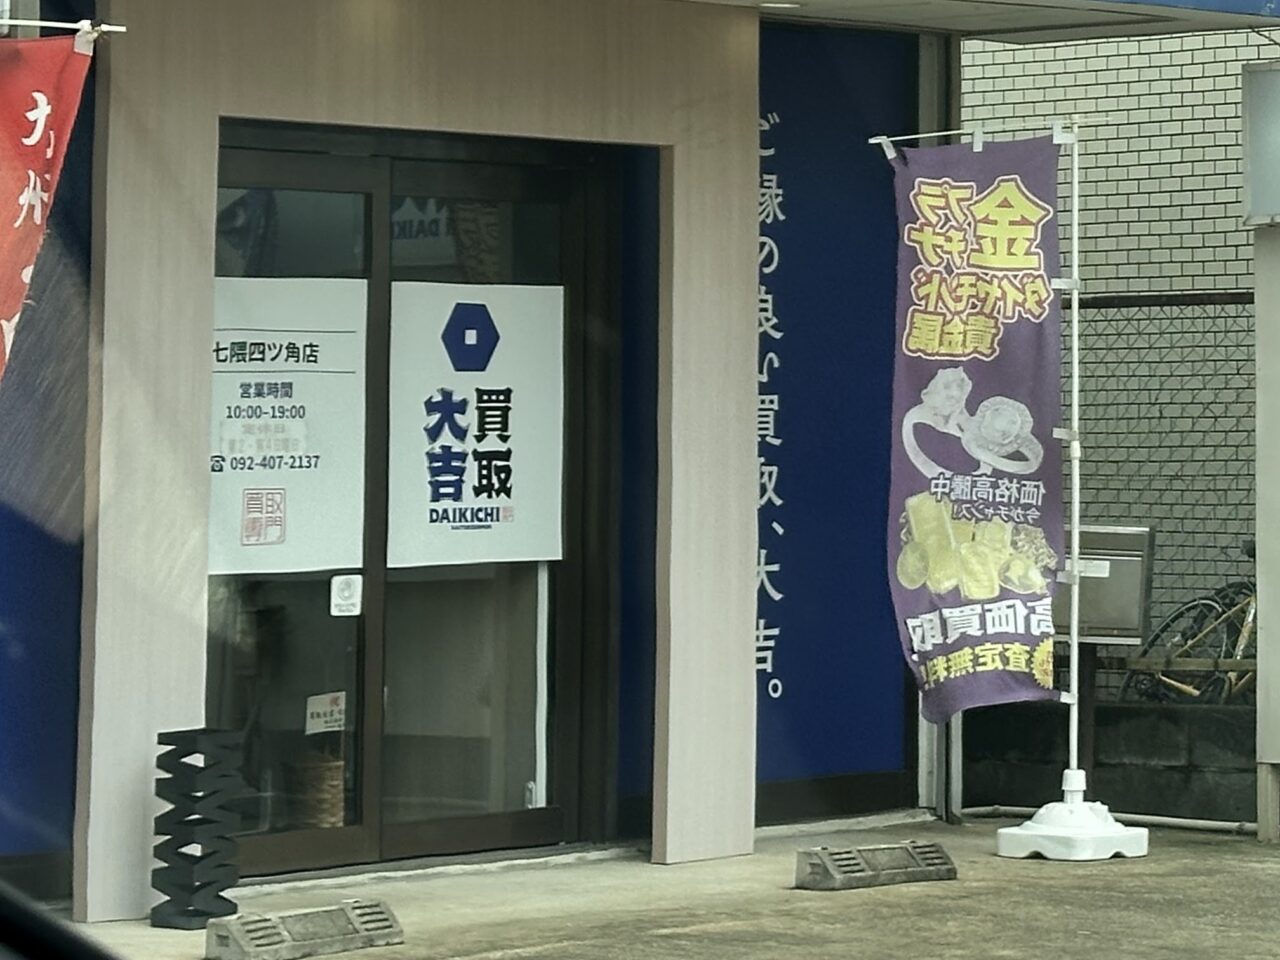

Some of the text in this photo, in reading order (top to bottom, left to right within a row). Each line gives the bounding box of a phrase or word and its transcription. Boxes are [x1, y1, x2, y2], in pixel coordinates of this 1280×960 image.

[212, 341, 319, 364] 七隈四ツ角店
[240, 382, 293, 399] 営業時間
[226, 405, 306, 420] 10:00-19:00
[423, 387, 470, 503] 大吉
[472, 386, 513, 500] 買取
[230, 455, 320, 471] 092-407-2137
[429, 506, 501, 524] DAIKICHI
